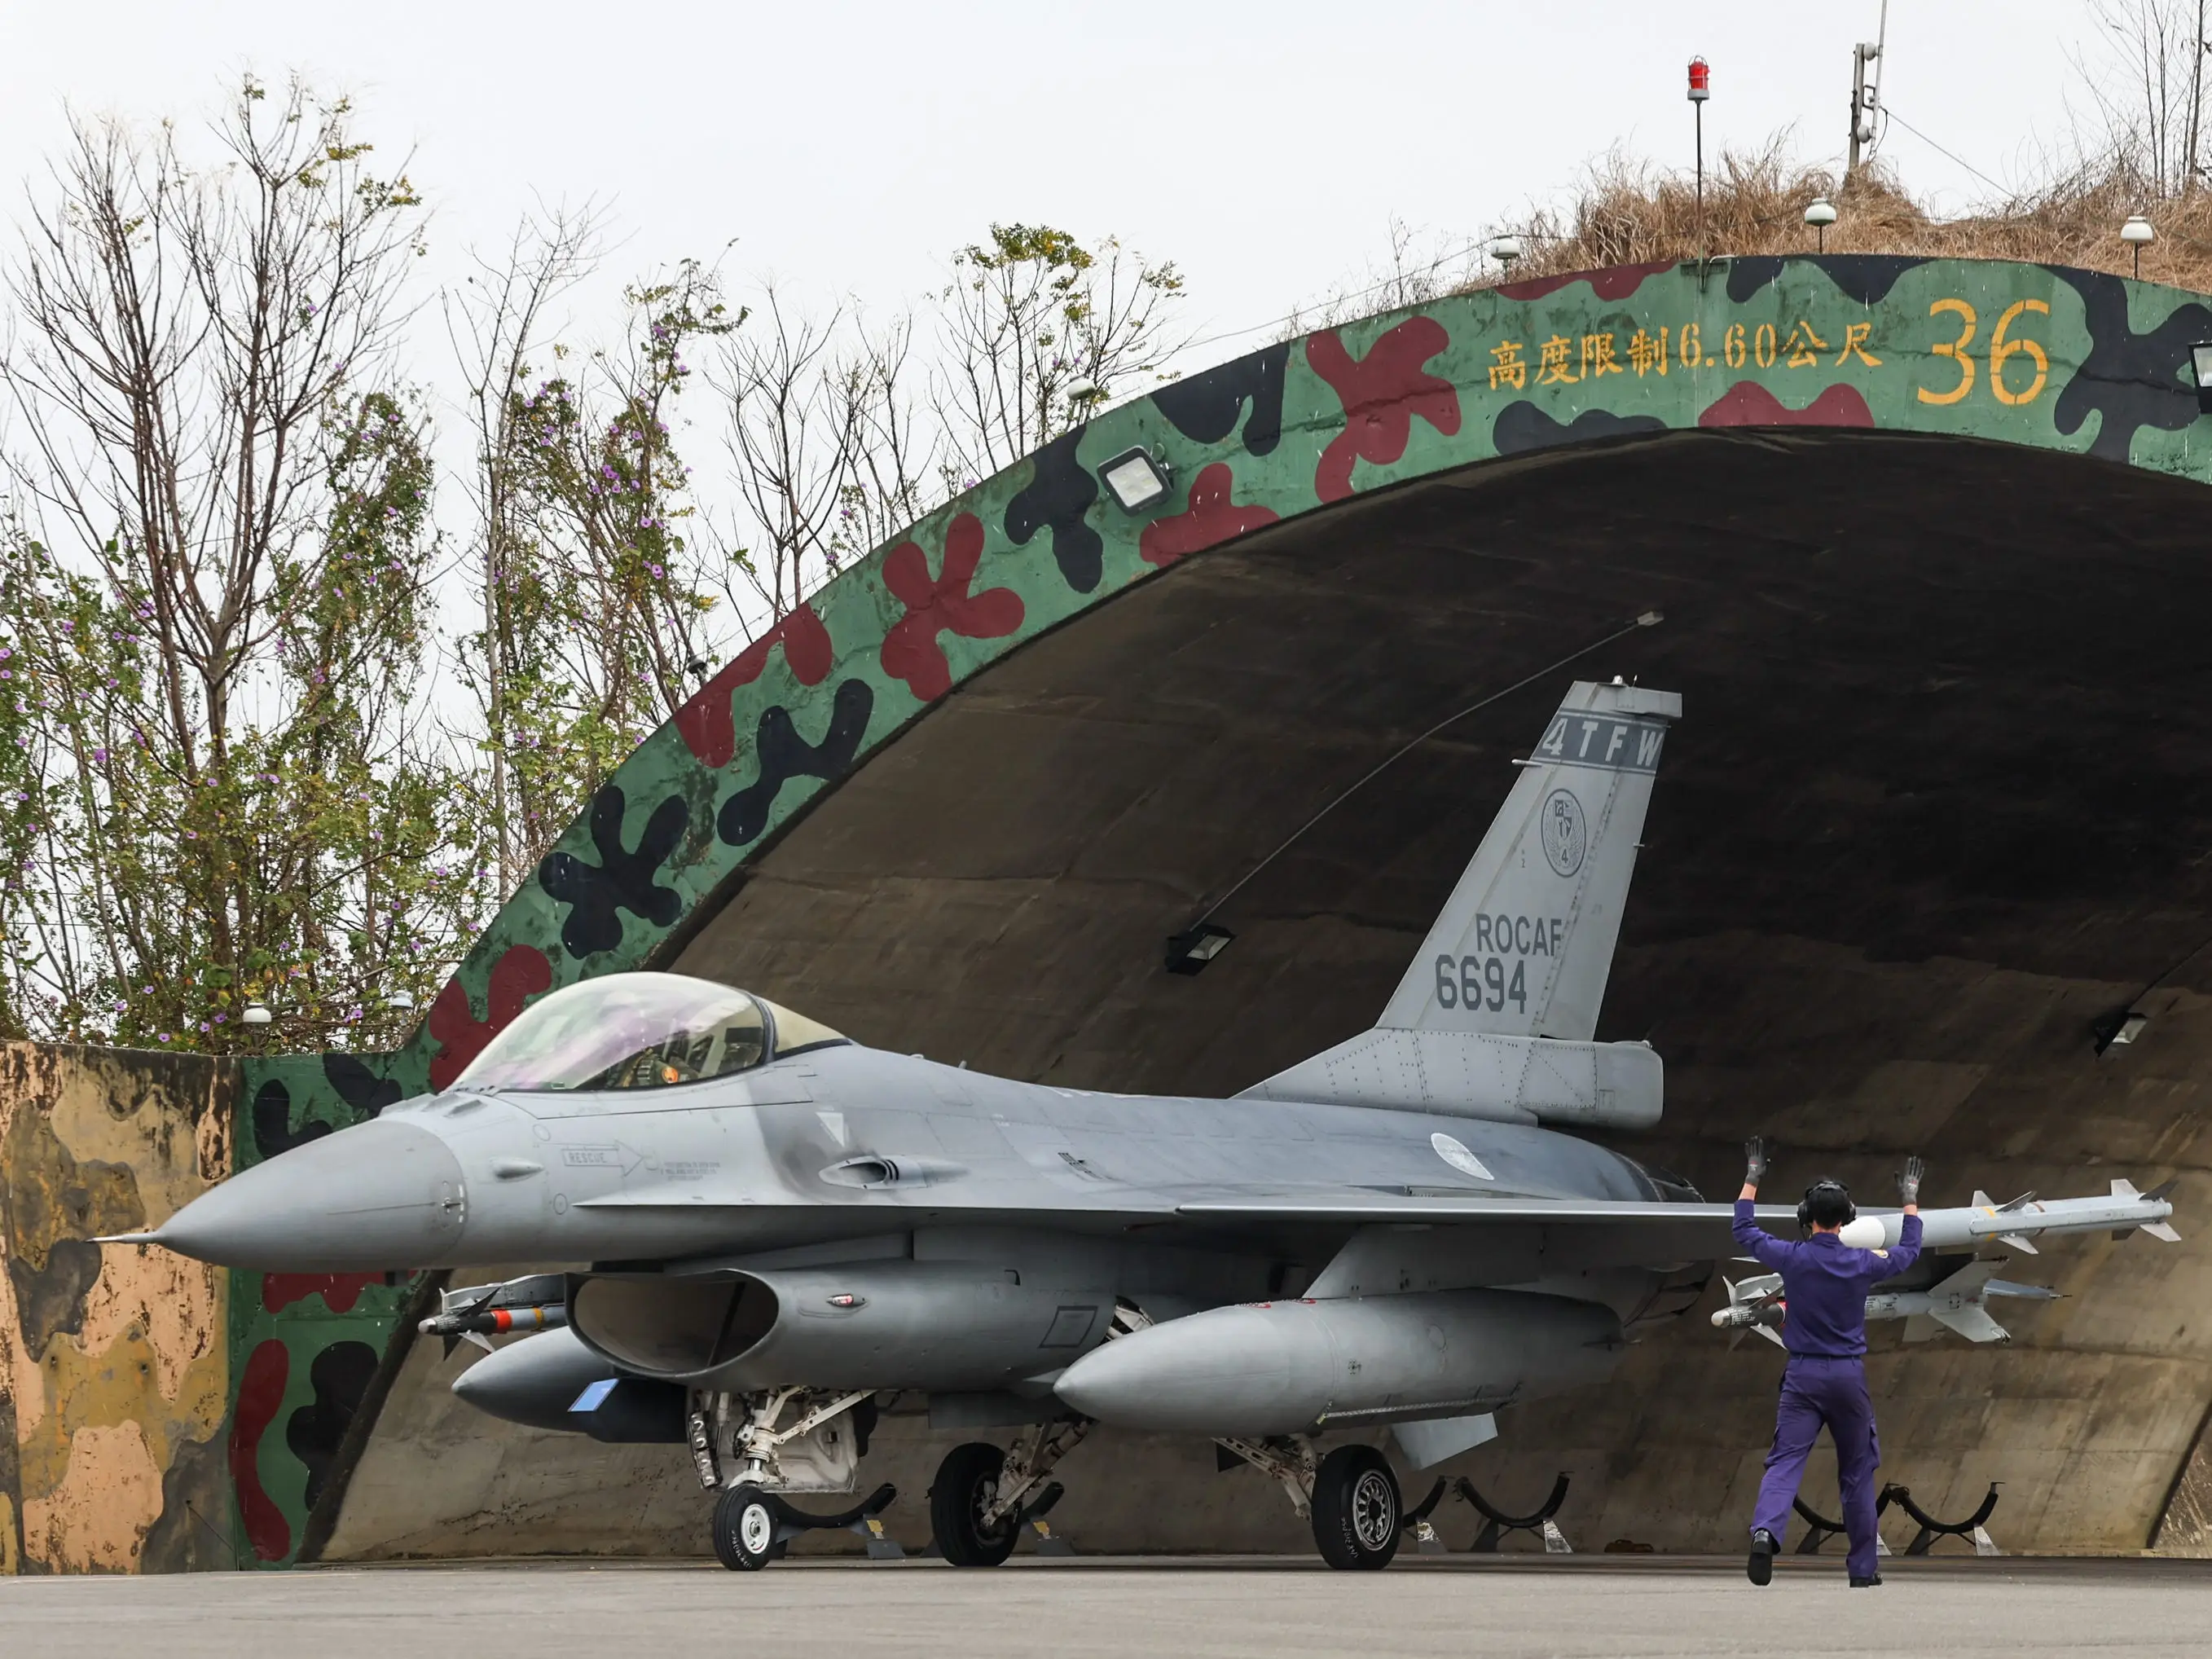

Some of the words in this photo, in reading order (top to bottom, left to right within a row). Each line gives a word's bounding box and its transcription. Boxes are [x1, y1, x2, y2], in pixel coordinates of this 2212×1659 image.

[1489, 320, 1882, 390] 高度限制6.60公尺
[1918, 298, 2049, 405] 36
[1542, 718, 1664, 767] 4TFW
[1561, 848, 1568, 864] 4
[1475, 913, 1562, 956] ROCAF
[1435, 954, 1527, 1014] 6694
[569, 1152, 607, 1164] RESCUE
